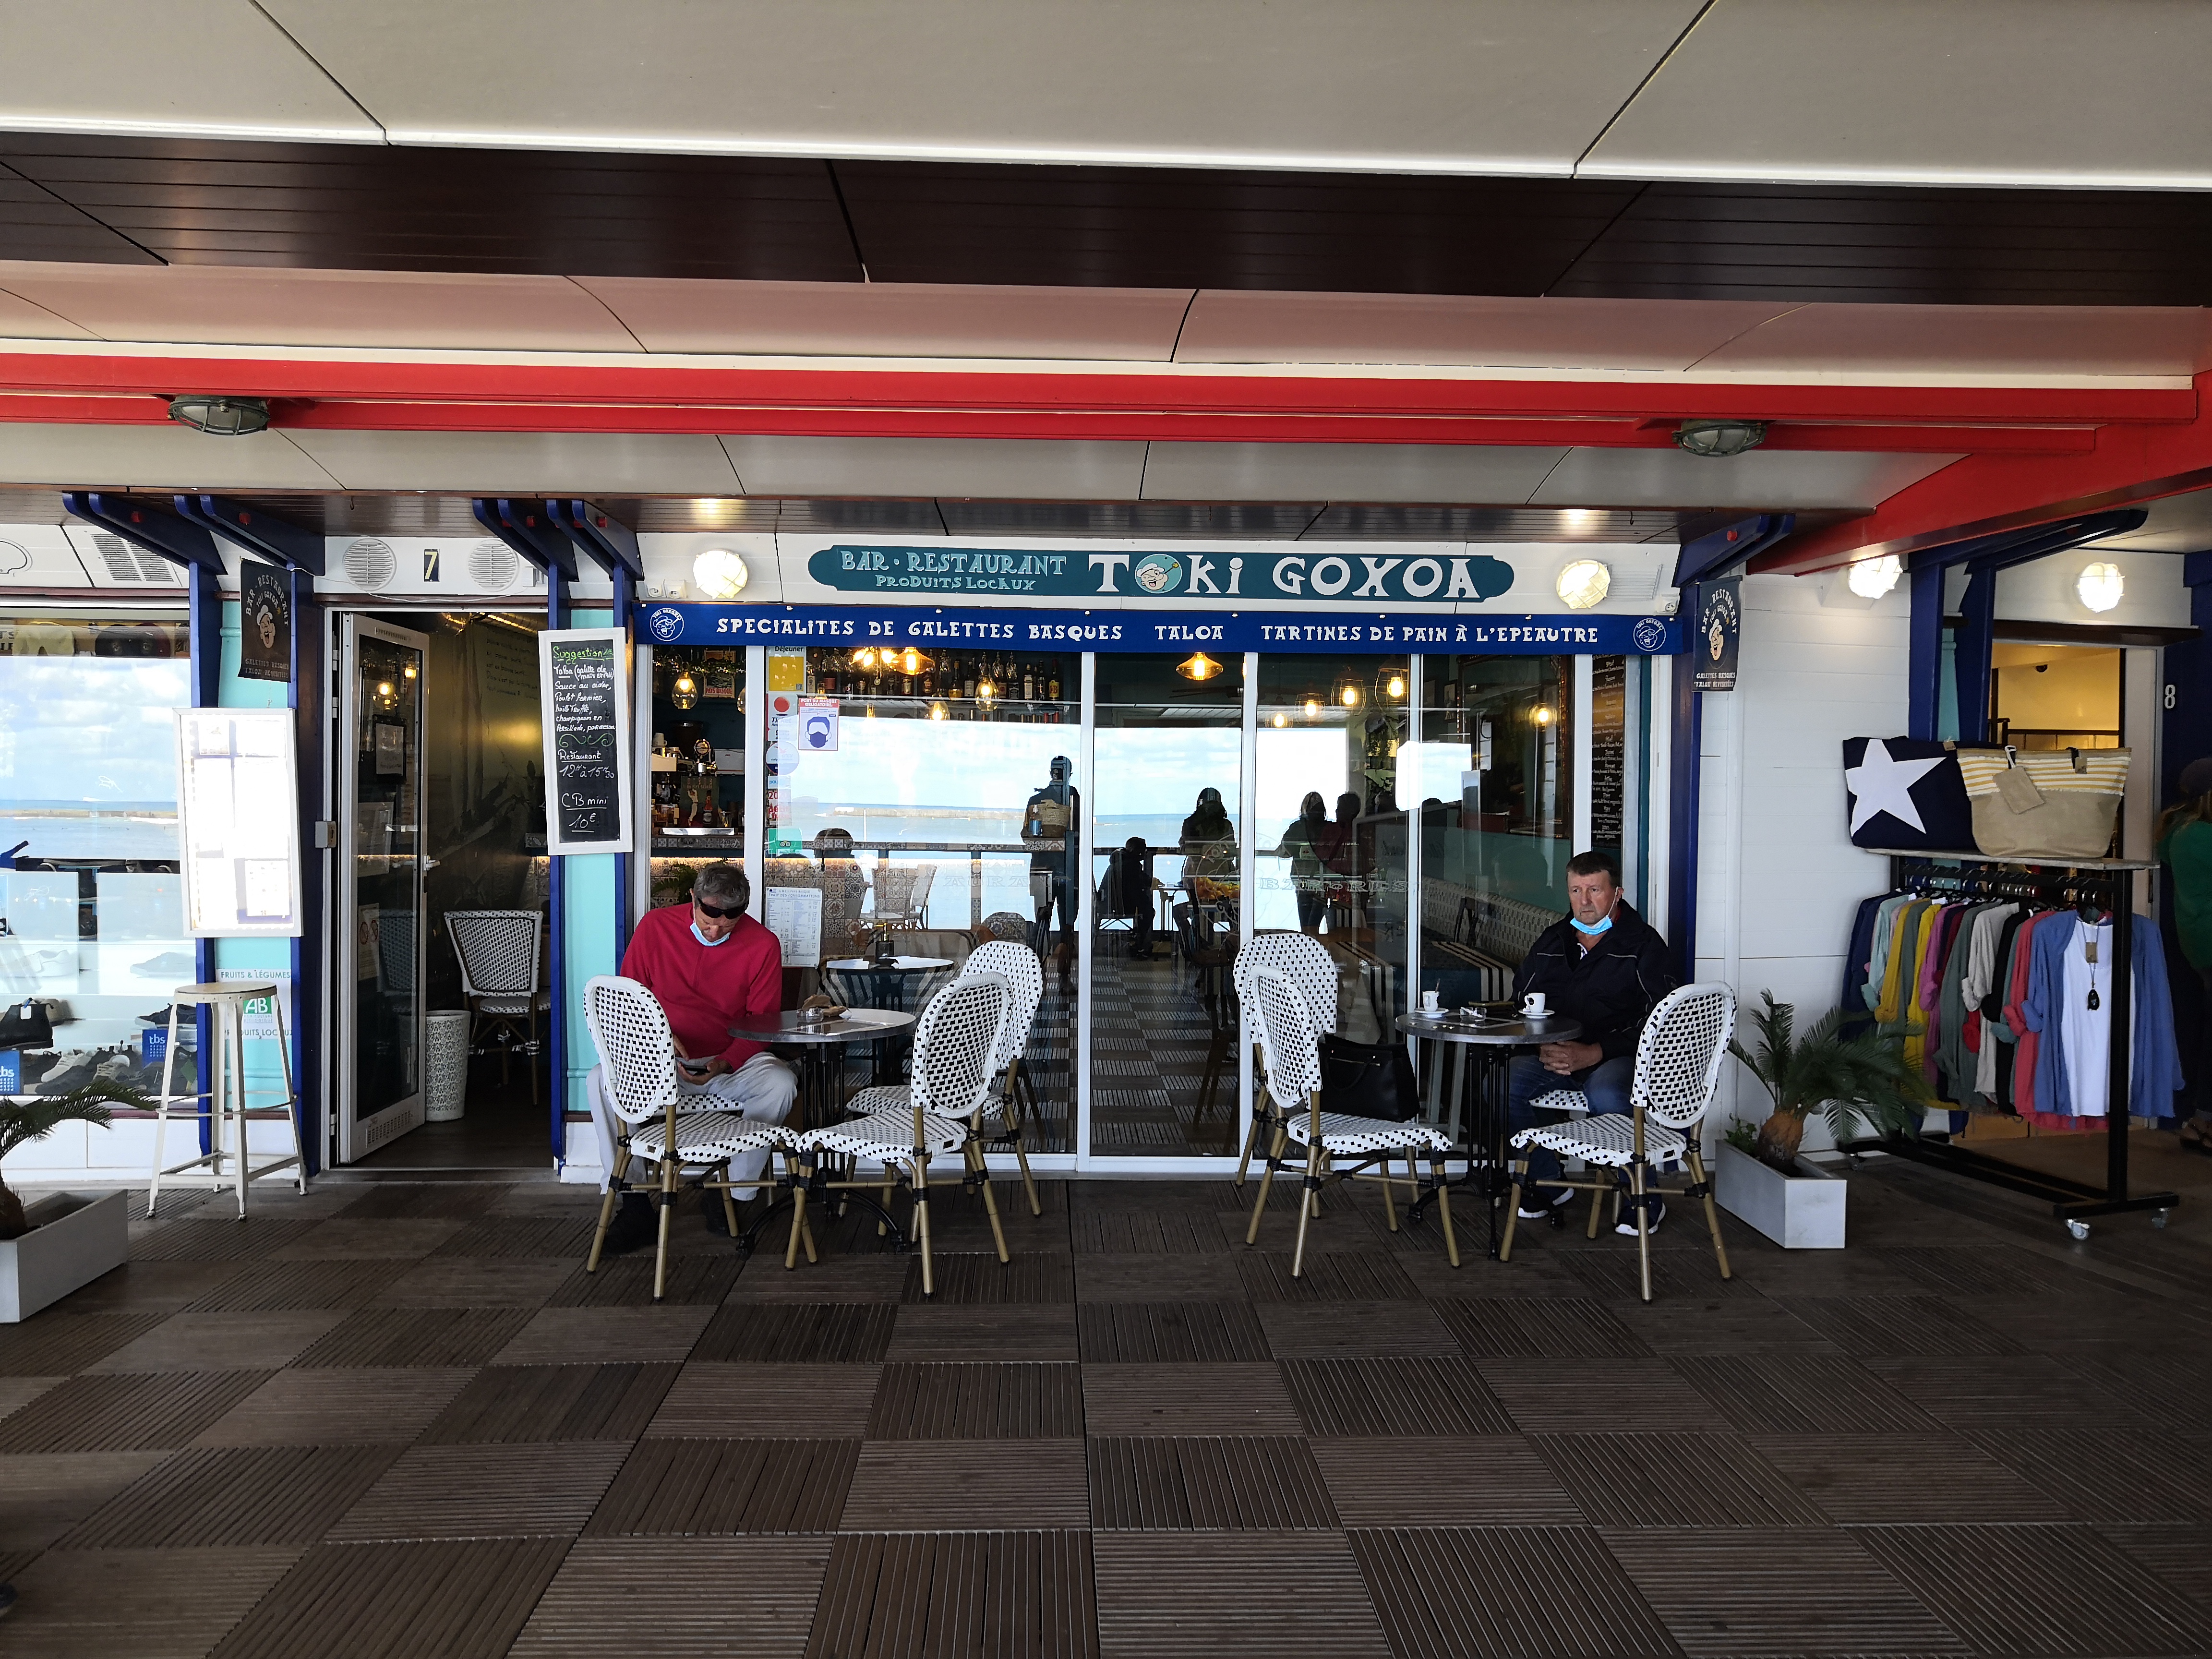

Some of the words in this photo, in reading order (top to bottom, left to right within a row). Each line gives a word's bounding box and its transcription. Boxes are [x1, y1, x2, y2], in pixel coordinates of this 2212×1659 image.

[425, 552, 438, 579] 7
[840, 551, 890, 570] BAR
[906, 552, 1067, 577] RESTAURANT
[965, 577, 1036, 590] LOCAUX
[1272, 556, 1481, 599] GOXOA
[868, 621, 894, 636] DE
[908, 622, 1014, 638] GALETTES
[1029, 625, 1122, 641] BASQUES
[1155, 625, 1223, 640] TALOA
[1370, 627, 1394, 641] DE
[1455, 625, 1467, 641] À
[555, 681, 576, 690] Sauce
[2164, 685, 2176, 709] 8
[558, 749, 601, 760] Restaurant
[587, 796, 608, 805] mini
[255, 970, 290, 978] LÉGUMES
[245, 998, 268, 1013] AB
[149, 1034, 166, 1044] tbs
